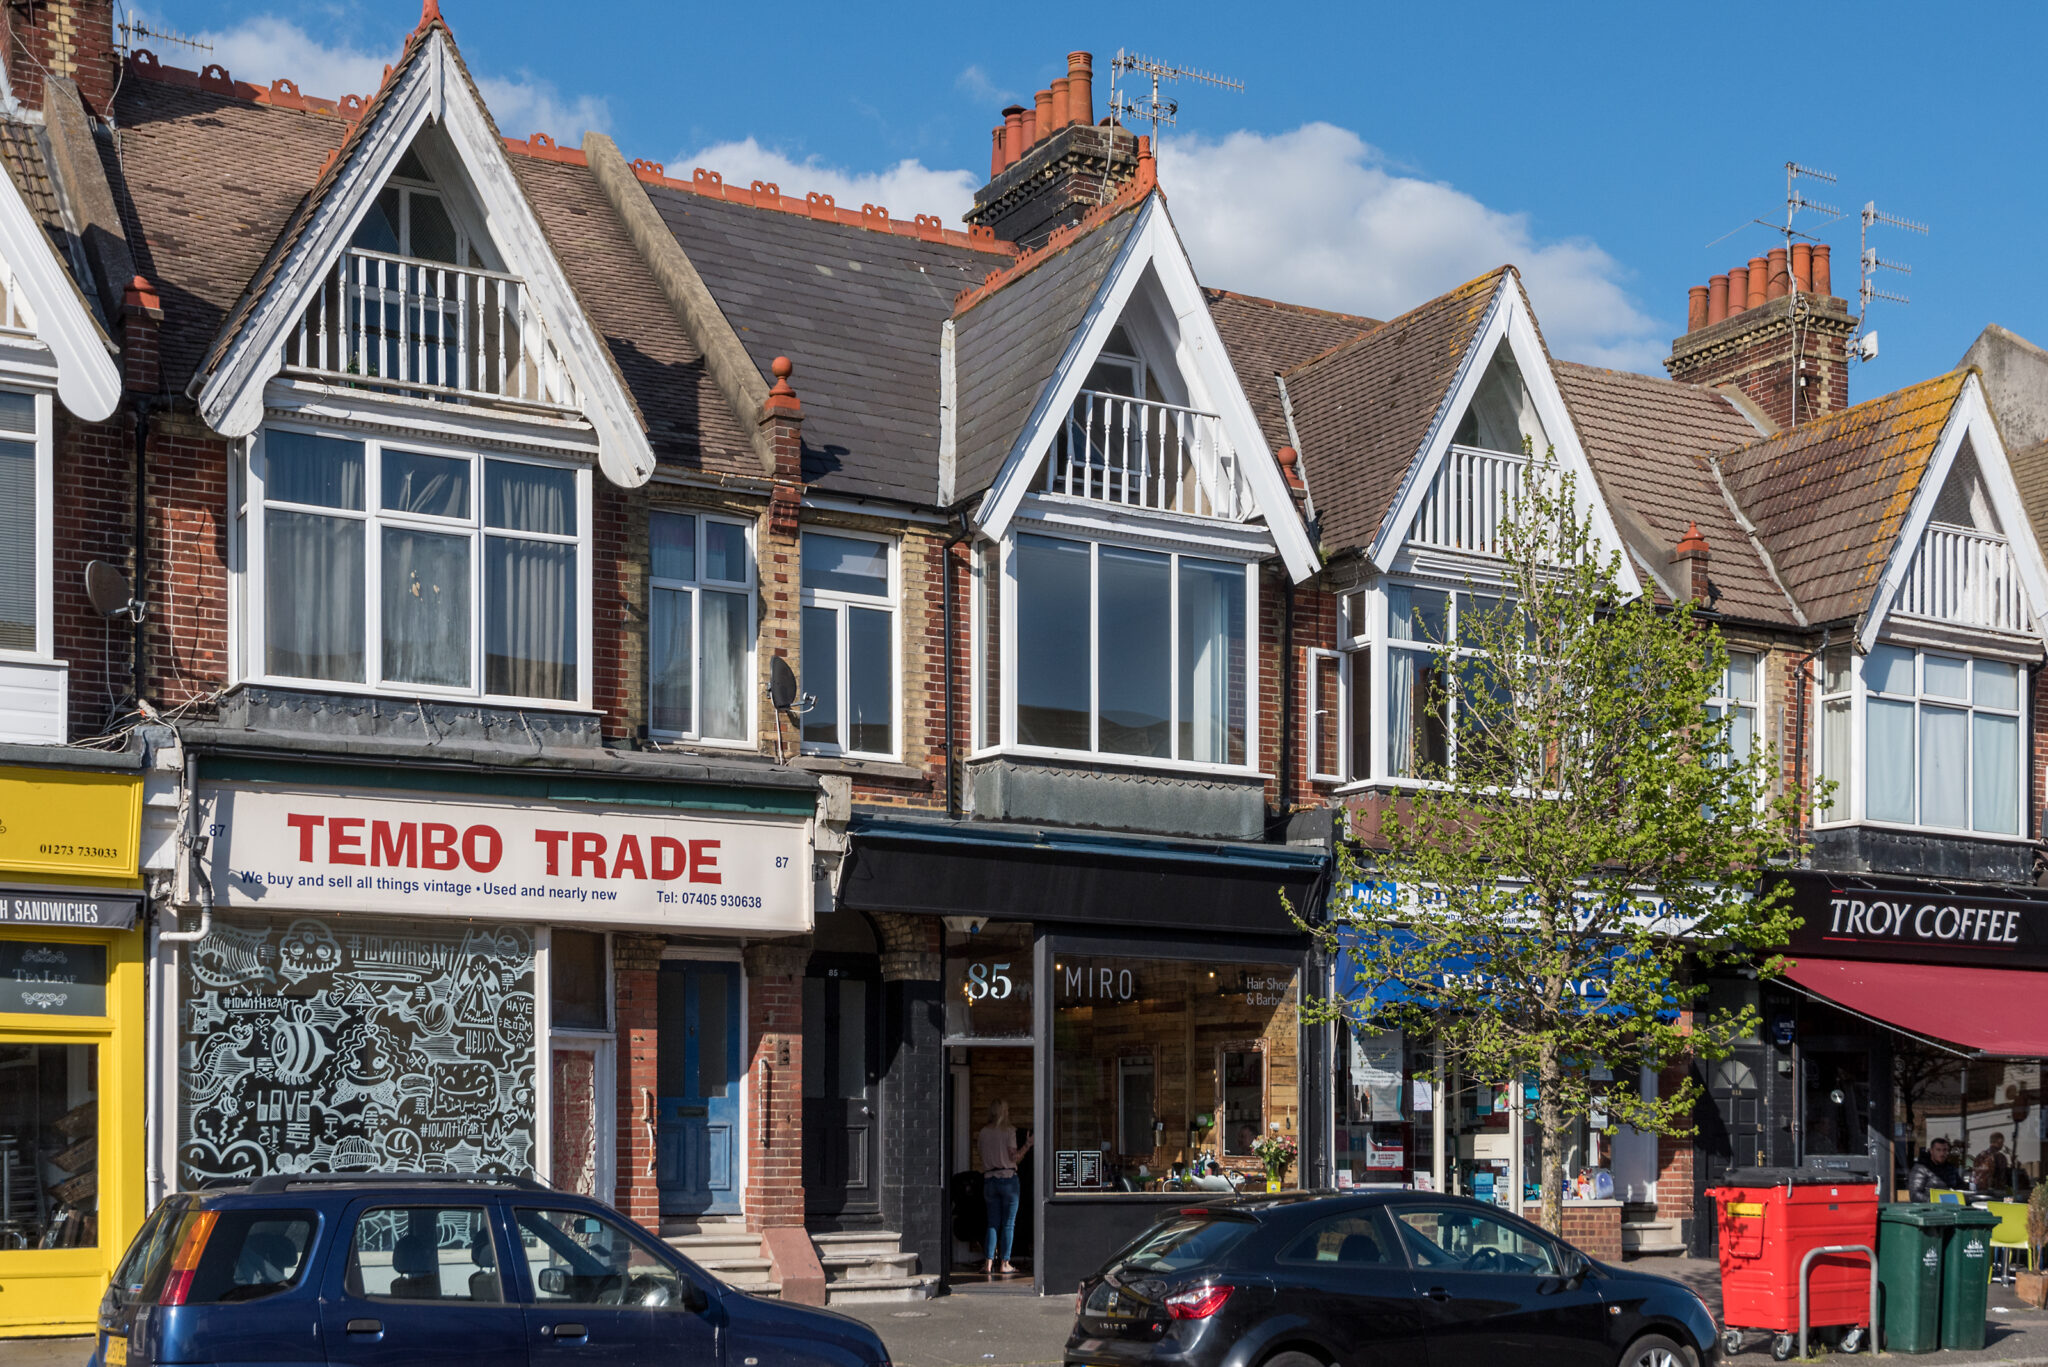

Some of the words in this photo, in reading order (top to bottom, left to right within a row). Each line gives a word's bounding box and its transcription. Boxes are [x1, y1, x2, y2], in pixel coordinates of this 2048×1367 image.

[209, 824, 226, 838] 87
[40, 844, 74, 856] 01273
[78, 846, 118, 858] 733033
[287, 813, 503, 874] TEMBO
[535, 829, 722, 885] TRADE
[775, 856, 789, 868] 87
[240, 871, 263, 885] We
[268, 873, 294, 888] buy
[299, 875, 324, 887] and
[329, 876, 352, 888] sell
[357, 877, 373, 889] all
[377, 878, 419, 893] things
[424, 880, 472, 895] vintage
[483, 882, 517, 896] Used
[521, 885, 545, 898] and
[549, 888, 588, 903] nearly
[591, 889, 618, 901] new
[656, 891, 679, 904] Tel:
[682, 892, 717, 906] 07405
[720, 894, 762, 909] 930638
[1357, 888, 1393, 906] NHS
[15, 899, 98, 924] SANDWICHES
[1830, 899, 1912, 936] TROY
[1914, 904, 2021, 943] COFFEE
[828, 969, 839, 977] 85
[967, 962, 1012, 999] 85
[1065, 966, 1132, 1000] MIRO
[1246, 977, 1265, 990] Hair
[1266, 977, 1290, 992] Shop
[1246, 992, 1254, 1005] &
[506, 1001, 534, 1015] HAVE
[503, 1018, 534, 1032] BOOM
[513, 1013, 526, 1022] A
[507, 1030, 534, 1042] DAY
[257, 1090, 311, 1122] LOVE
